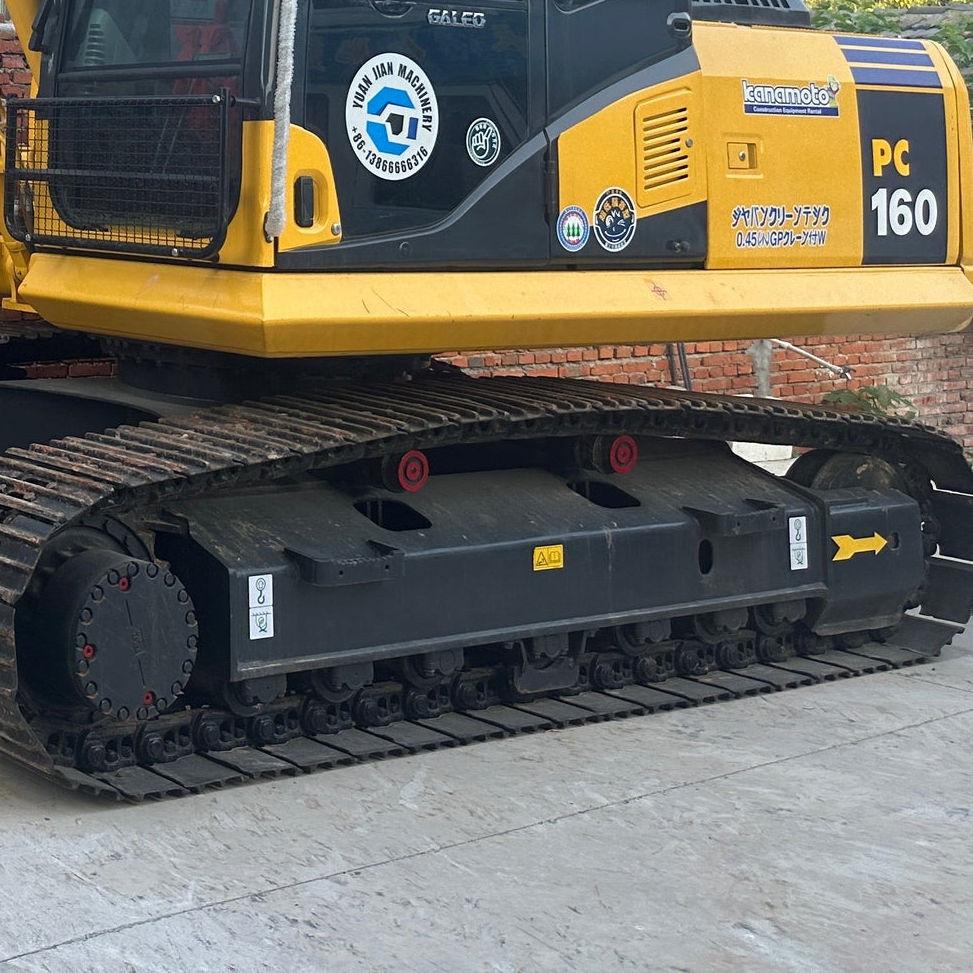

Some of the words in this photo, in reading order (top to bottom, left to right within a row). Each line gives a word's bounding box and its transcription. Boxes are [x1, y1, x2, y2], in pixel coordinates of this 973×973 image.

[427, 8, 487, 29] GALEO
[352, 74, 373, 109] YUAN
[372, 61, 394, 81] JIAN
[397, 63, 433, 133] MACHINERY
[741, 79, 831, 106] kanamoto
[783, 106, 806, 115] Equipment
[871, 138, 910, 177] PC
[871, 188, 938, 236] 160
